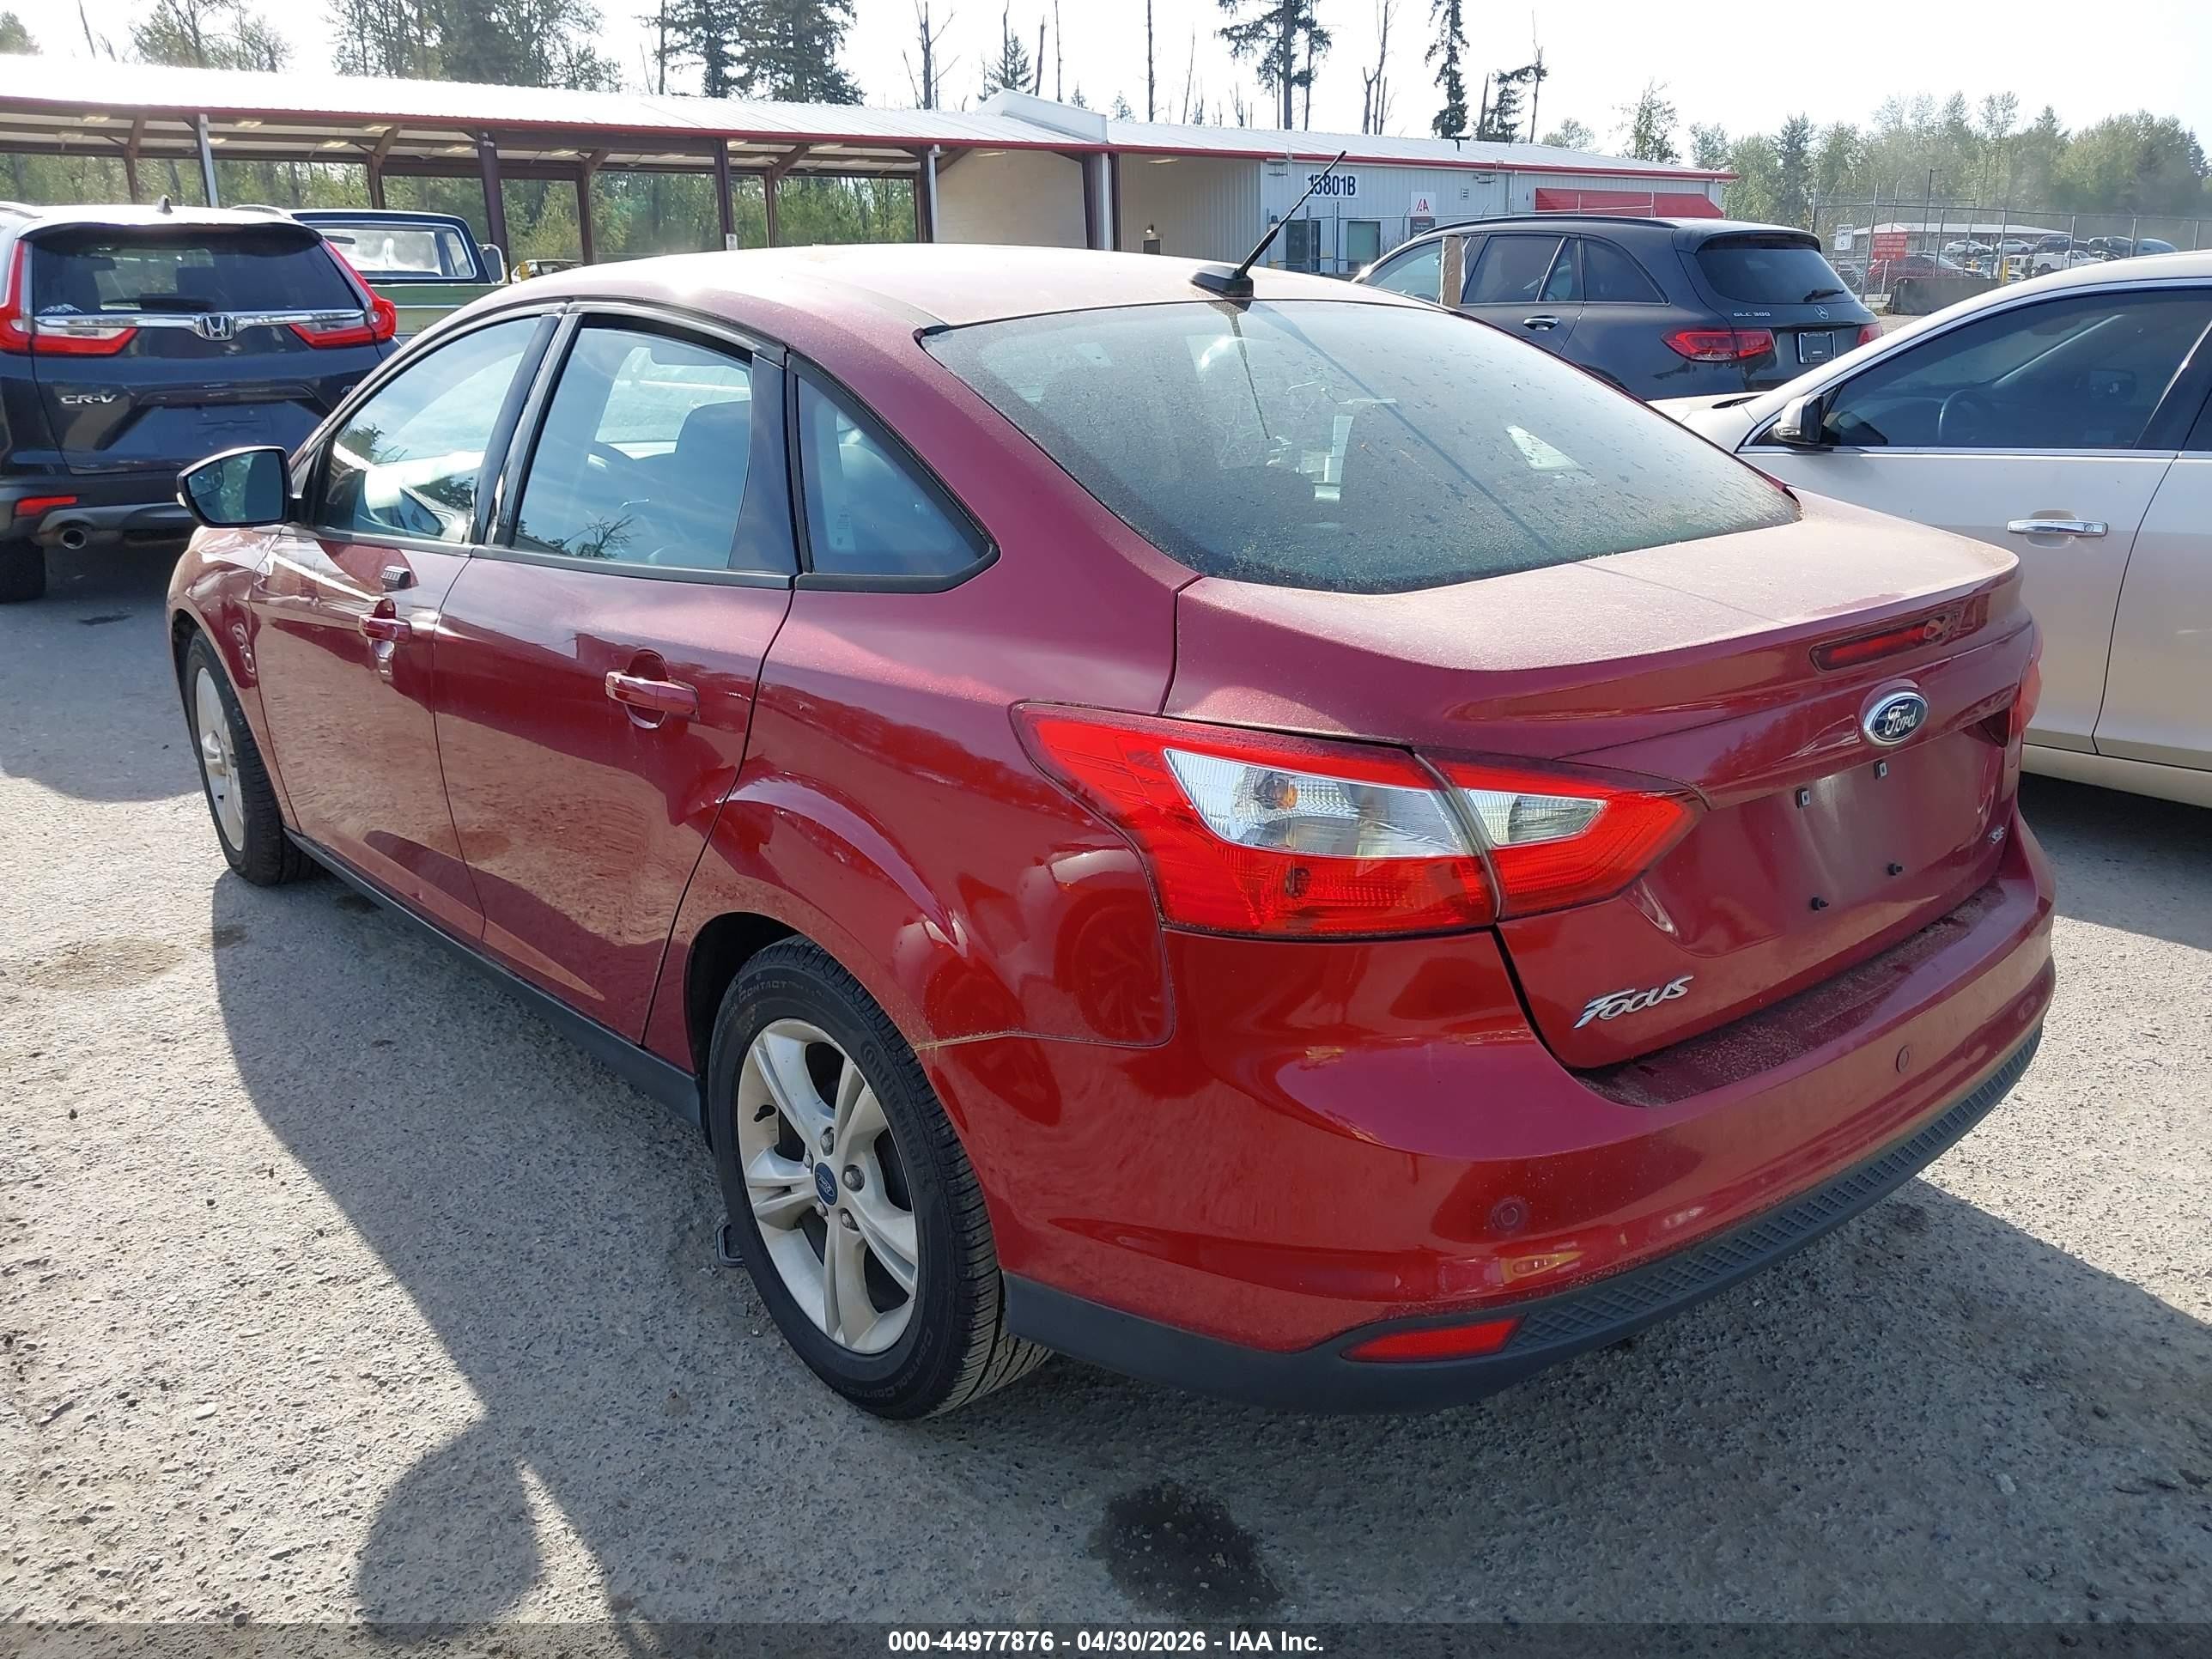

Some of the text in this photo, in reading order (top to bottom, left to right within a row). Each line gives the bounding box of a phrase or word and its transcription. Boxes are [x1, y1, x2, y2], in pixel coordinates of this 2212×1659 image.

[1307, 174, 1356, 197] 15801B
[61, 394, 117, 404] CR-V
[1885, 703, 1917, 736] Ford
